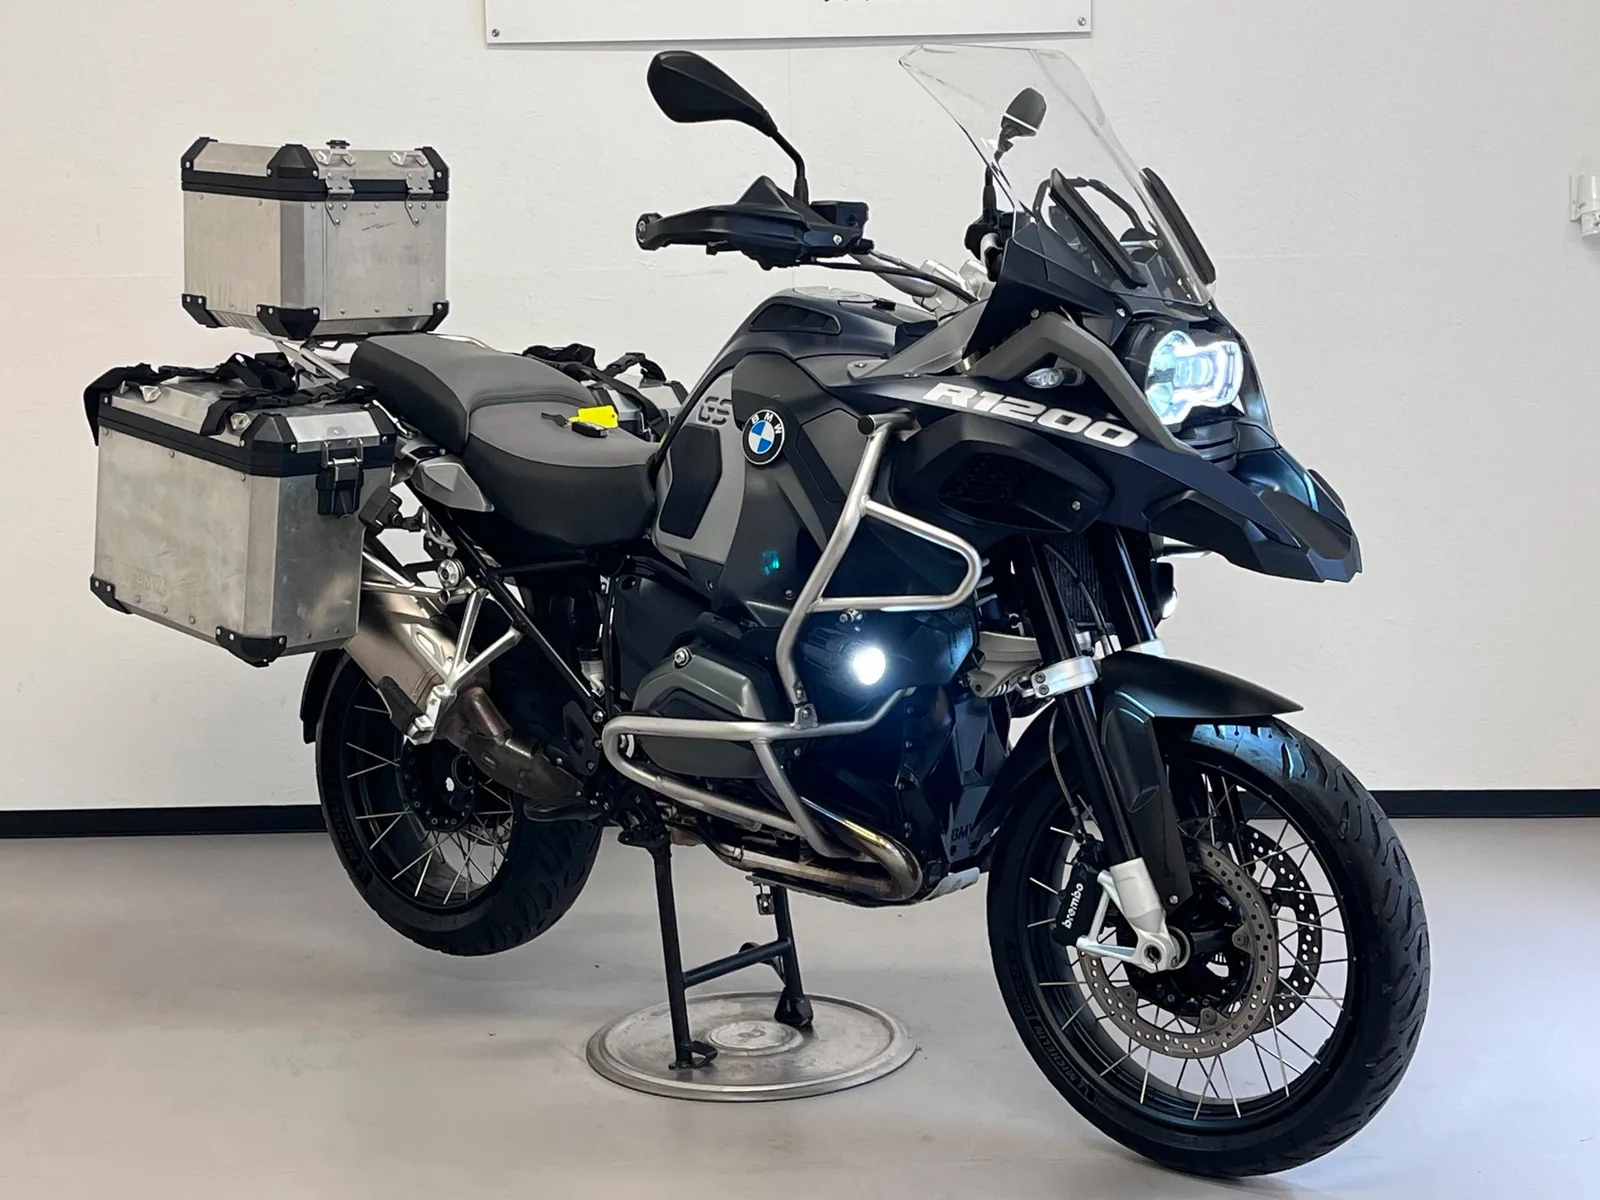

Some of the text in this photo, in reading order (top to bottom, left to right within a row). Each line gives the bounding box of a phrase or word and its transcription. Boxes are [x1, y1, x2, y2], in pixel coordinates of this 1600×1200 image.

[698, 396, 732, 425] GS
[751, 412, 782, 434] BMW
[923, 382, 1139, 447] R1200
[136, 571, 166, 593] BMW
[1062, 883, 1083, 929] brembo
[1033, 1024, 1077, 1081] MICHELIN
